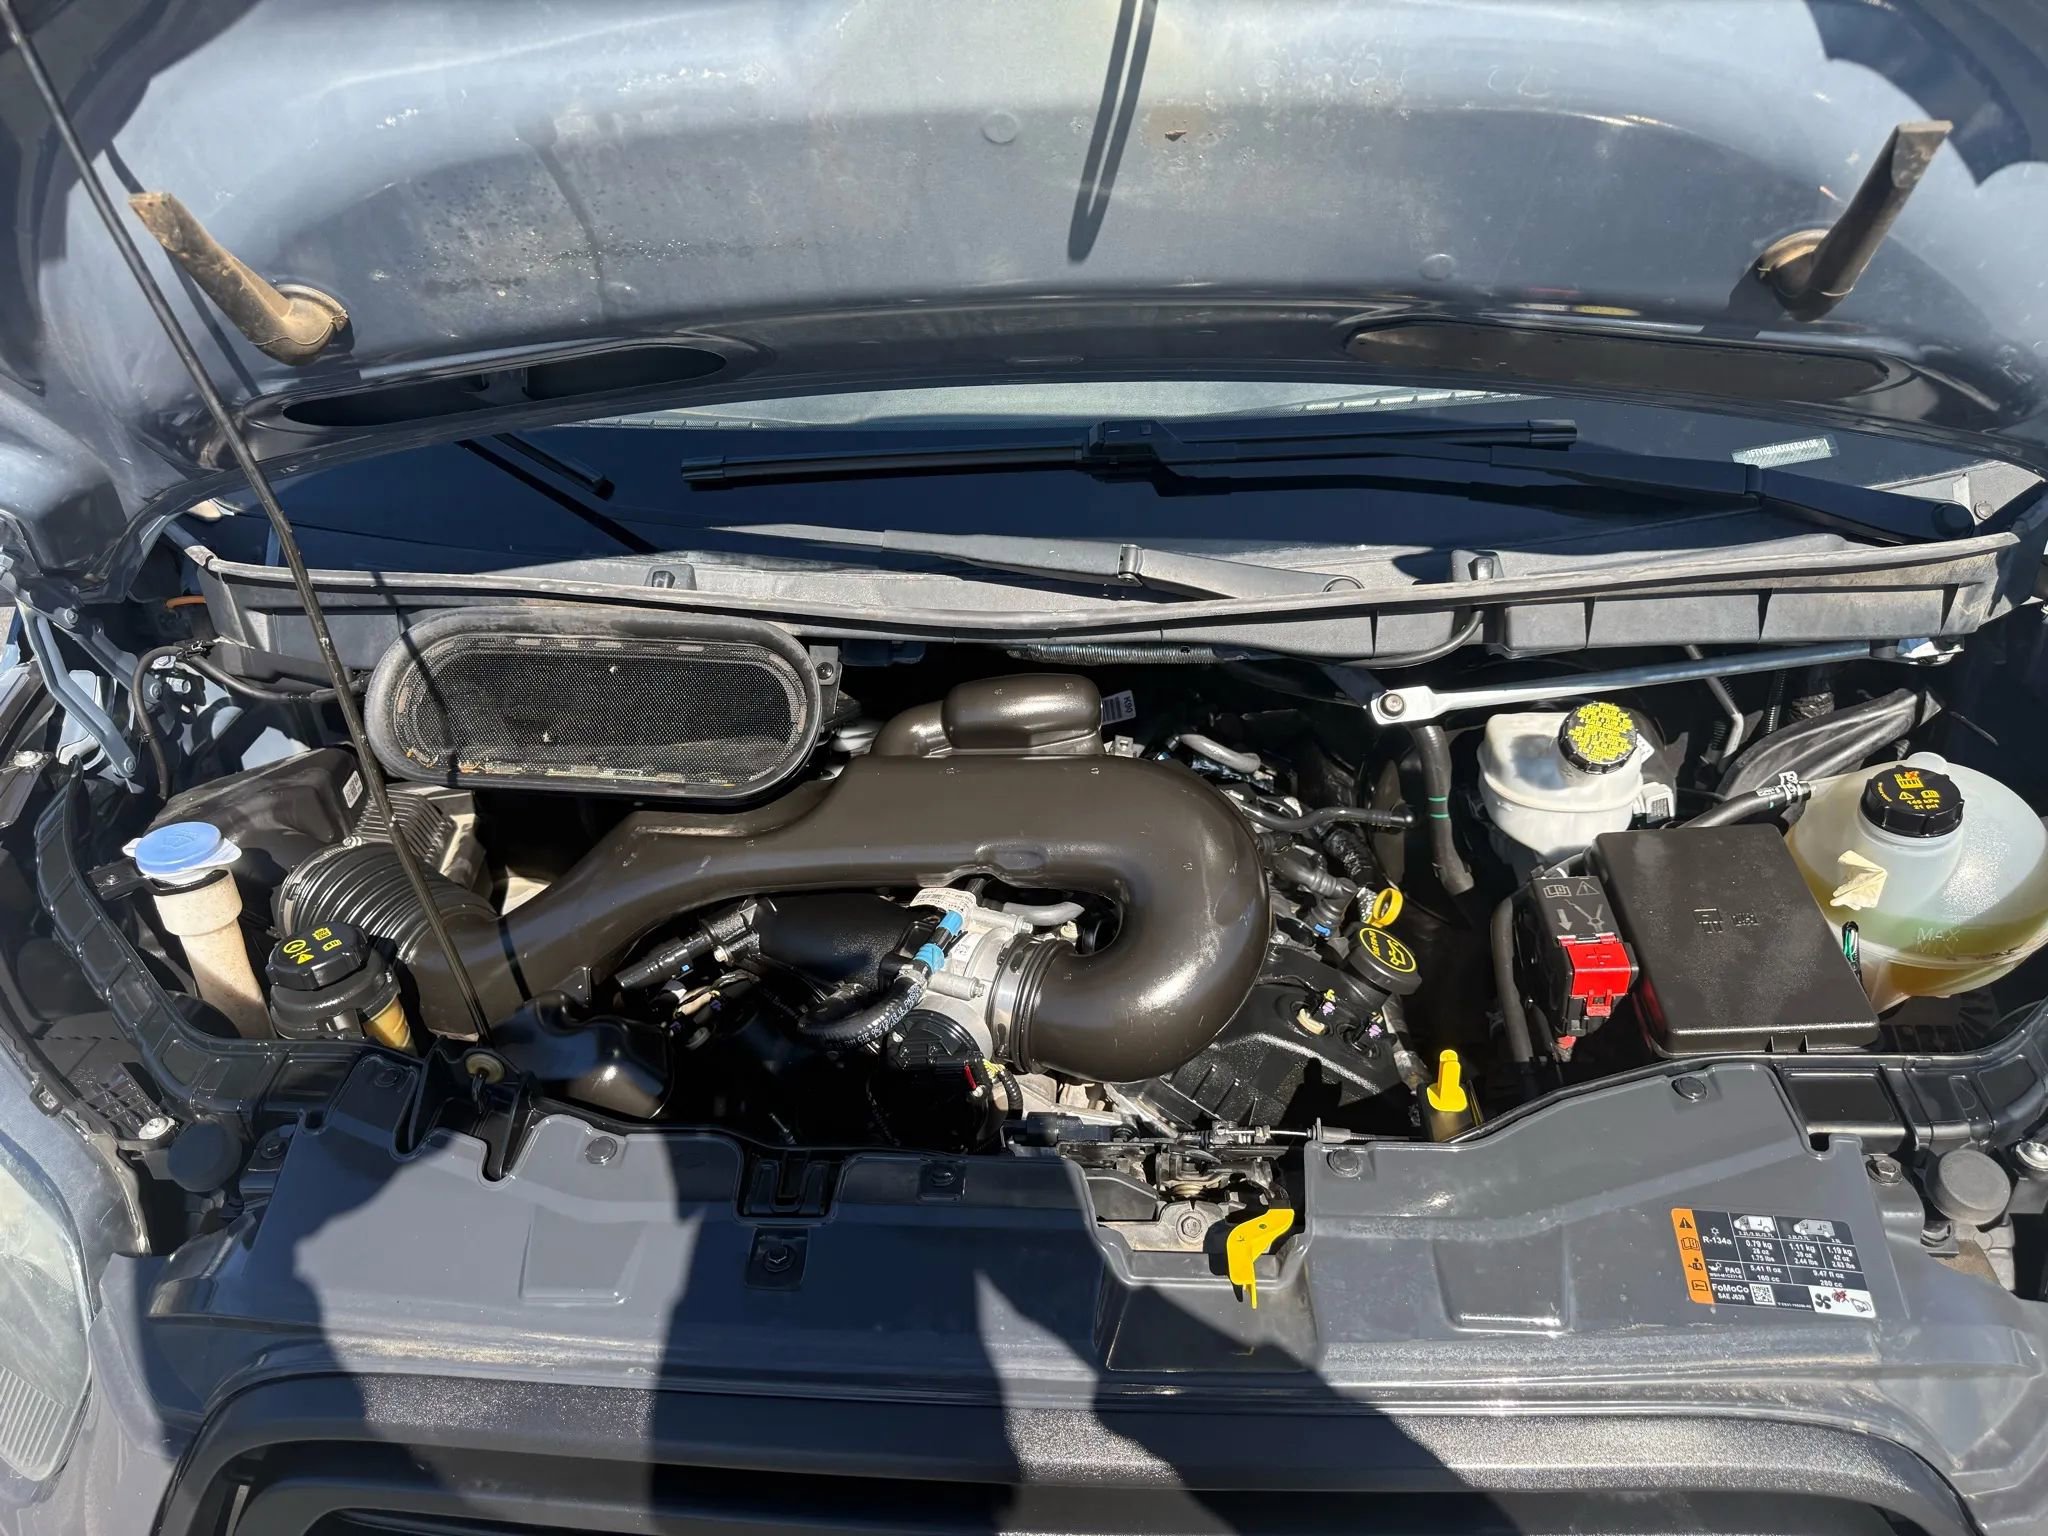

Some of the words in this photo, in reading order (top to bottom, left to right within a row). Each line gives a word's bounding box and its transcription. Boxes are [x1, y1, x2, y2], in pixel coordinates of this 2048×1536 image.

[1917, 928, 1960, 942] MAX
[1702, 1235, 1733, 1245] R-134a
[1745, 1239, 1761, 1248] 0.79
[1762, 1240, 1773, 1250] kg
[1805, 1244, 1816, 1253] kg
[1826, 1246, 1841, 1254] 1.19
[1842, 1247, 1853, 1257] kg
[1807, 1258, 1818, 1266] lbs
[1724, 1266, 1741, 1274] PAG
[1711, 1283, 1749, 1293] FoMoCo
